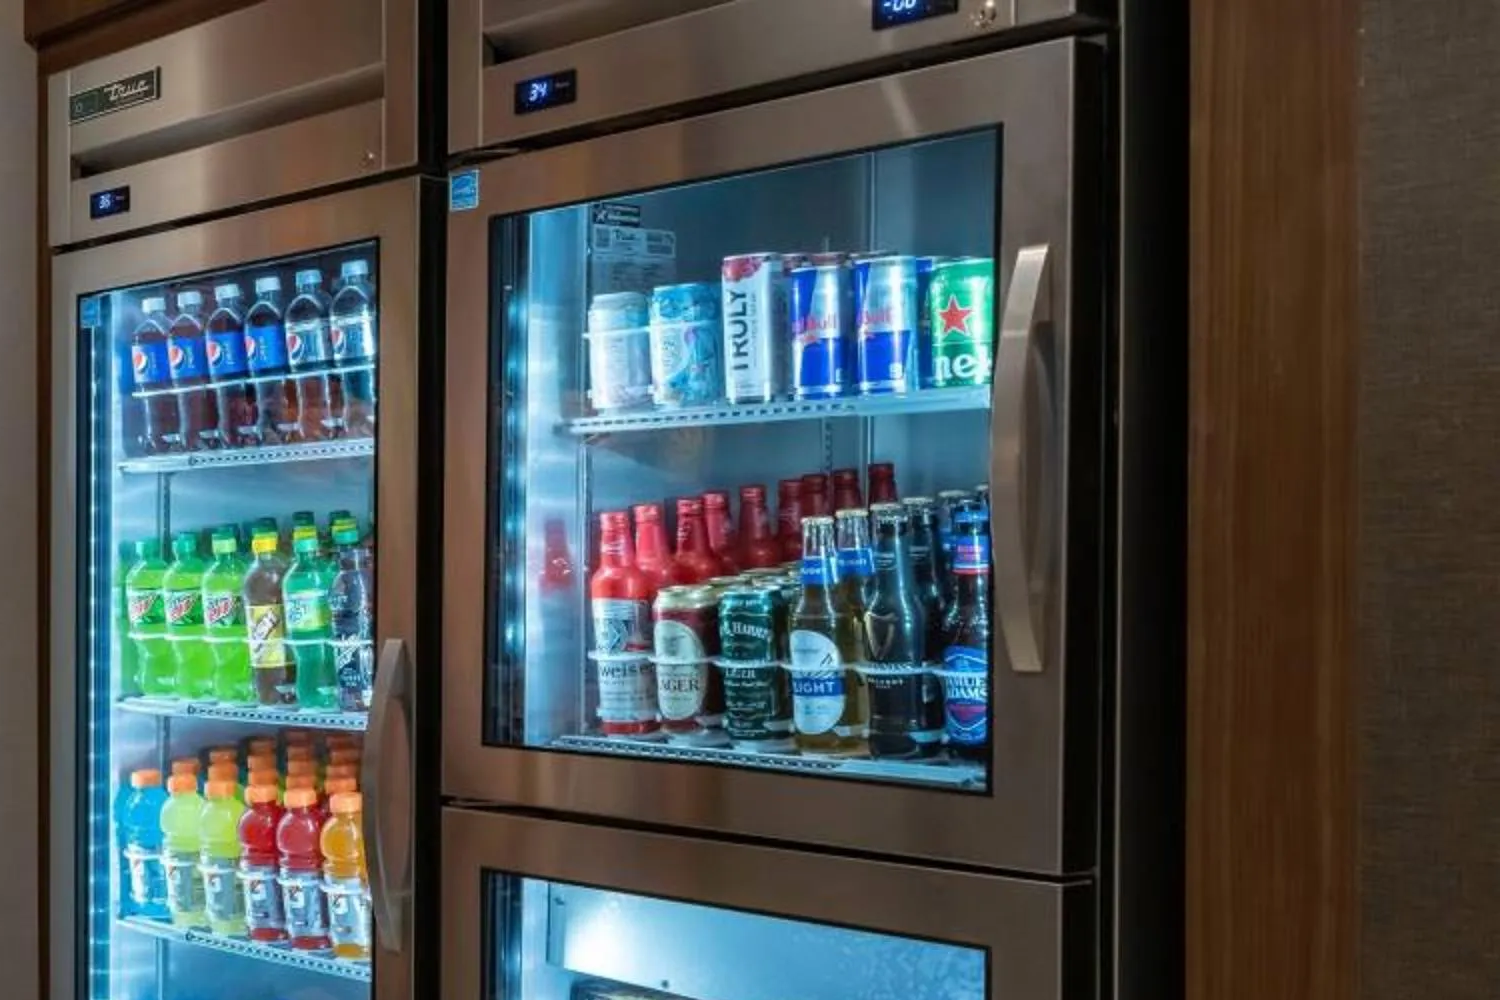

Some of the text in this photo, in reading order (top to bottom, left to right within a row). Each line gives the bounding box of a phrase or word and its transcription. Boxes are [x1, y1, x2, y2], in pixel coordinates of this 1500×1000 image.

[104, 77, 149, 100] True
[527, 82, 547, 102] 34
[793, 680, 835, 694] LIGHT
